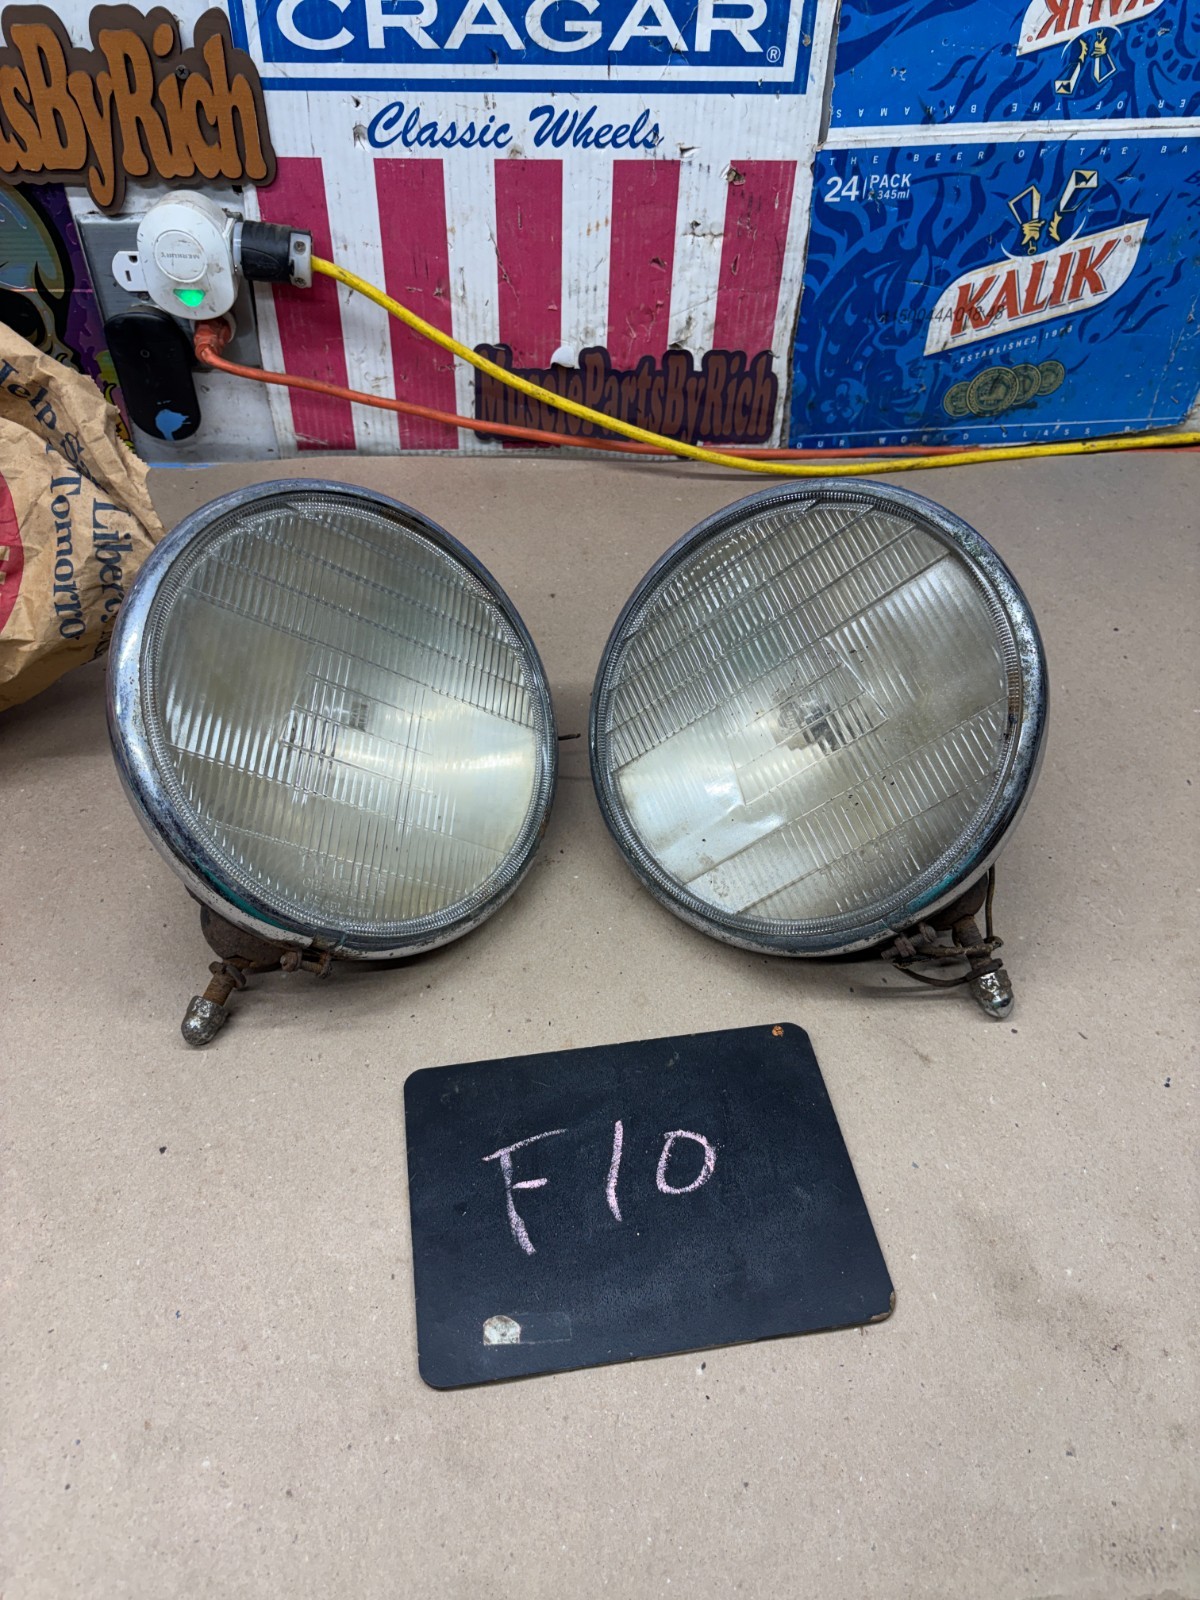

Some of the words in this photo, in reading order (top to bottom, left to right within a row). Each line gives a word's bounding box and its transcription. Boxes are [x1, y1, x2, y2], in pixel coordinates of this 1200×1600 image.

[276, 0, 765, 52] CRAGAR
[1012, 101, 1062, 112] THE
[1095, 100, 1124, 110] OF
[366, 101, 512, 149] Classic
[528, 104, 664, 149] Wheels
[829, 155, 879, 166] THE
[913, 151, 985, 162] BEER
[1018, 149, 1046, 158] OF
[1080, 146, 1129, 156] THE
[823, 175, 860, 203] 24
[869, 173, 912, 189] PACK
[877, 189, 910, 200] 345ml
[950, 237, 1121, 335] KALIK
[960, 335, 1037, 364] ESTABLISHED
[796, 440, 845, 449] OUR
